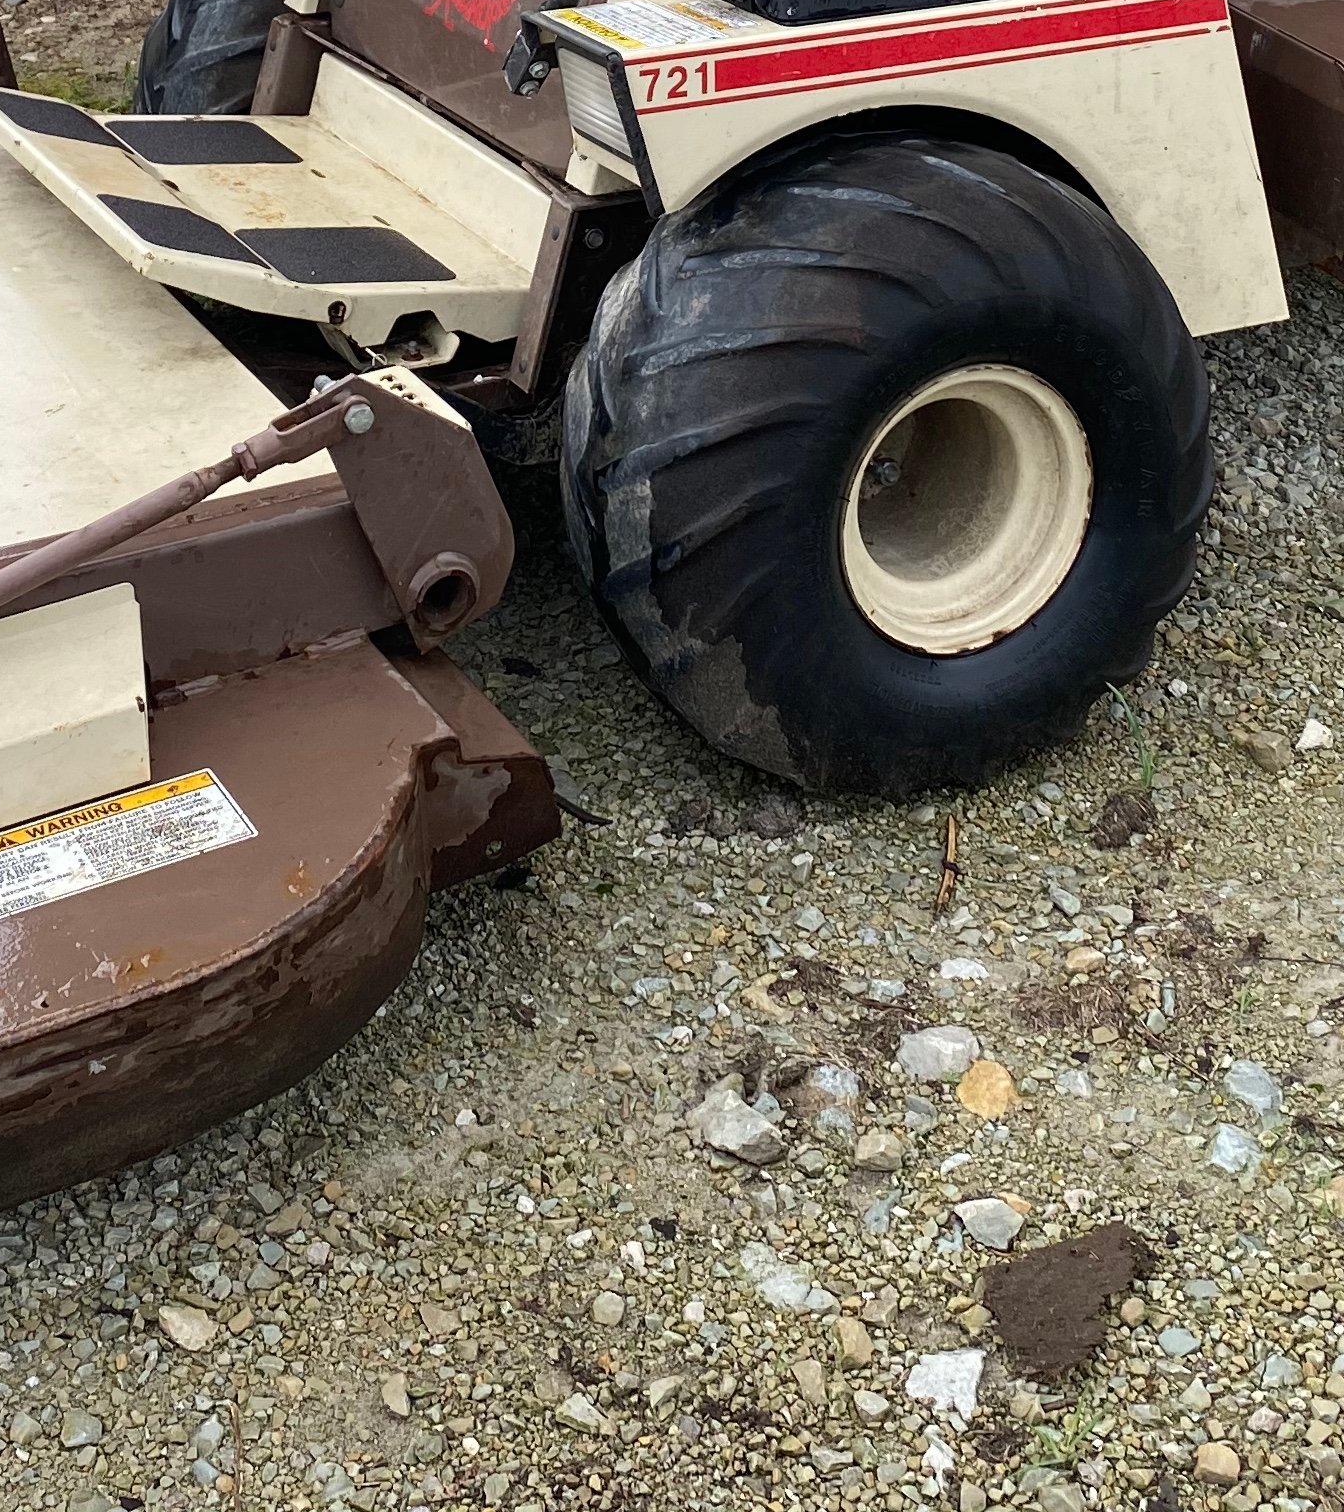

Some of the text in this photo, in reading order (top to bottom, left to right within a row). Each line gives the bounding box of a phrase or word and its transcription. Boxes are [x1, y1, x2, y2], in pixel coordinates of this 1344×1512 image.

[572, 16, 628, 41] CAUTION
[639, 61, 708, 103] 721
[26, 802, 123, 838] WARNING
